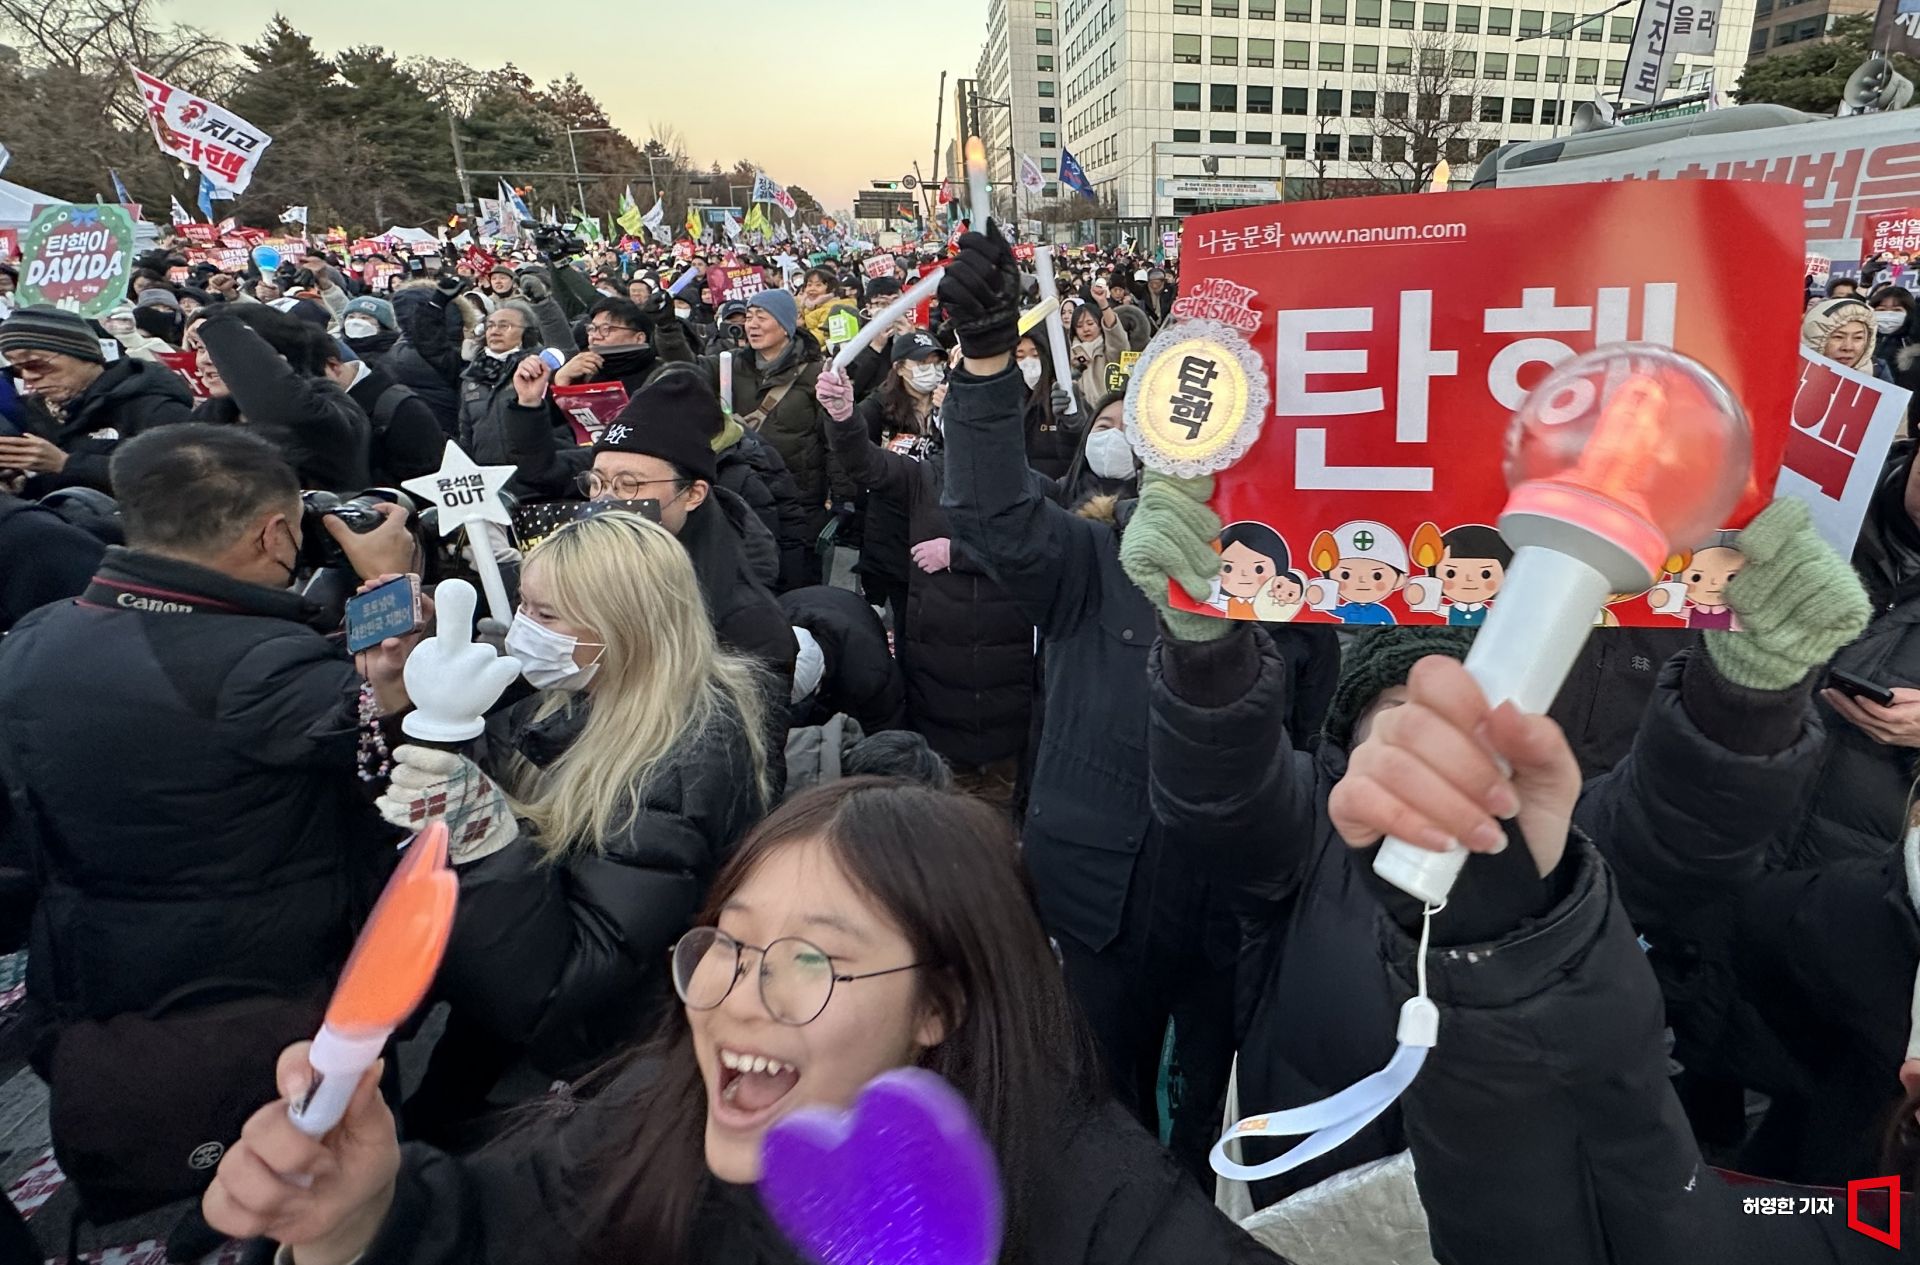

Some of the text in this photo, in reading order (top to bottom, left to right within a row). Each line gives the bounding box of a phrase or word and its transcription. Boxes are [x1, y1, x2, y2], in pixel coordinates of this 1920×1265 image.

[201, 118, 260, 153] 치고
[45, 228, 110, 257] 탄핵이
[1198, 222, 1467, 255] 나눔문화 www.nanum.com
[1874, 218, 1920, 238] 윤석열
[25, 250, 123, 287] DAVIDA
[1193, 278, 1256, 307] MERRY
[1172, 300, 1260, 330] CHRISTMAS
[1781, 354, 1883, 503] 핵
[437, 473, 485, 492] 윤석열
[443, 487, 485, 508] OUT
[117, 592, 194, 614] Canon
